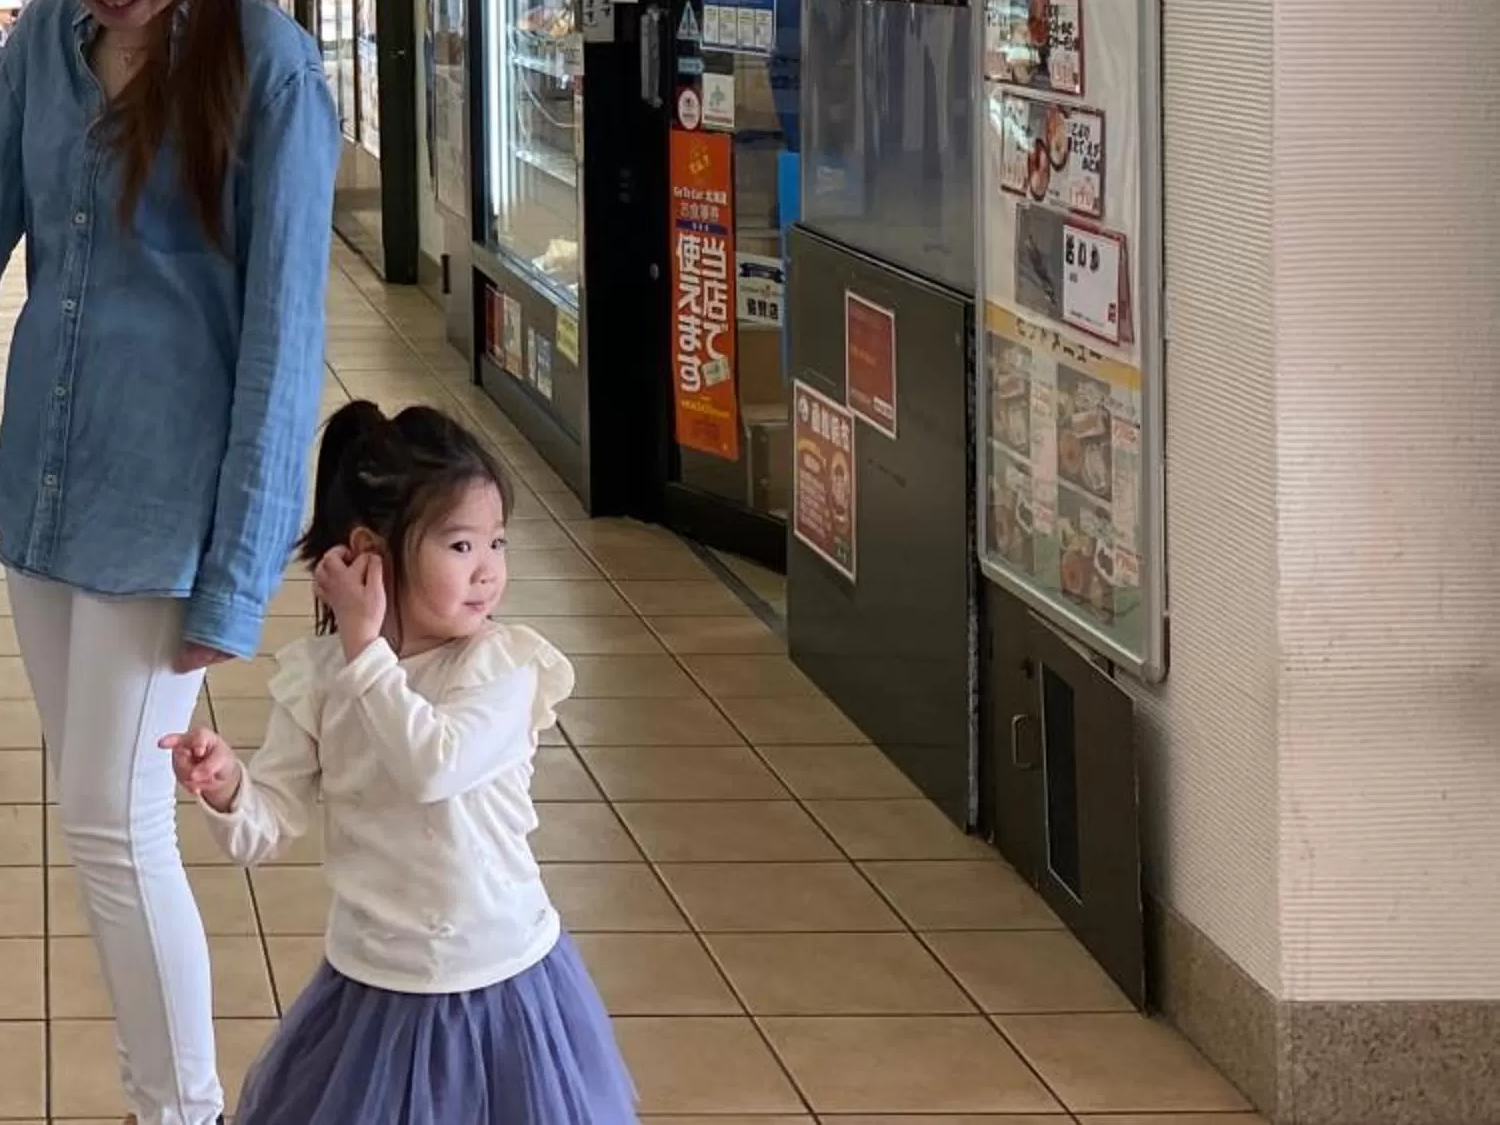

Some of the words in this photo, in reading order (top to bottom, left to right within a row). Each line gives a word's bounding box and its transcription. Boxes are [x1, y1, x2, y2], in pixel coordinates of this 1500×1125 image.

[676, 234, 703, 393] 使えます
[702, 237, 730, 361] 当店で
